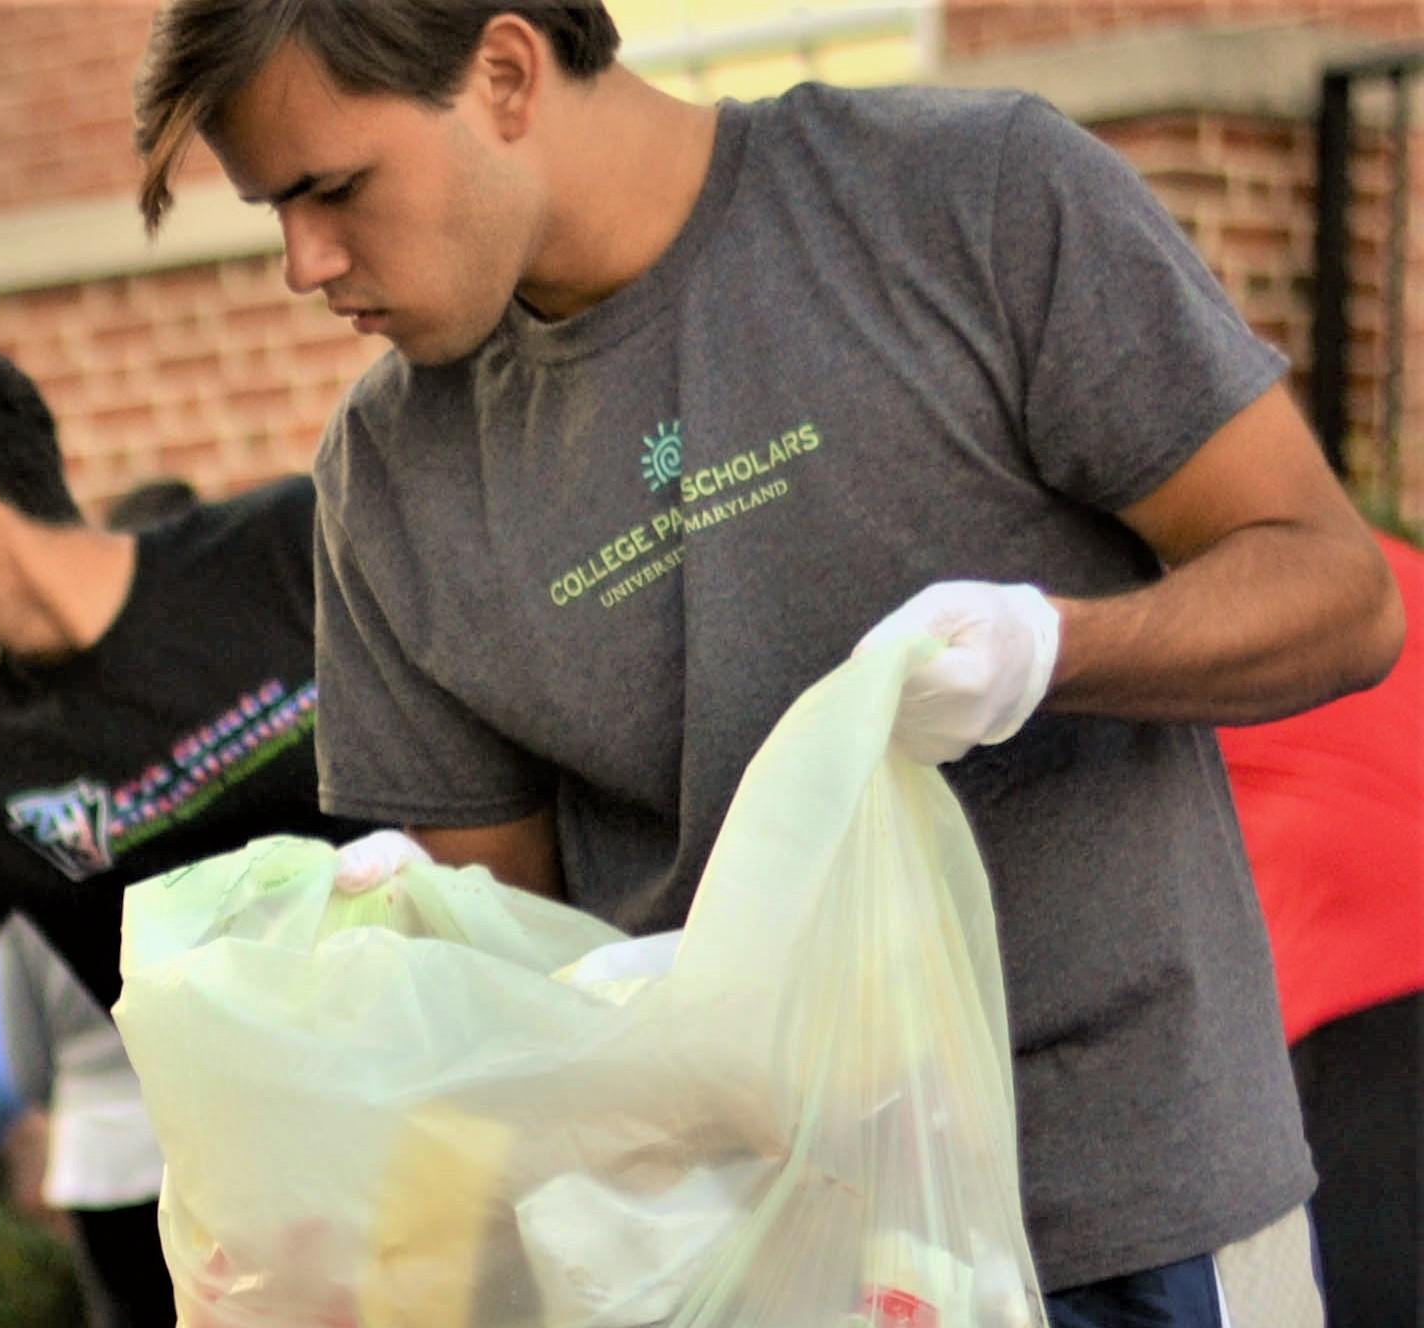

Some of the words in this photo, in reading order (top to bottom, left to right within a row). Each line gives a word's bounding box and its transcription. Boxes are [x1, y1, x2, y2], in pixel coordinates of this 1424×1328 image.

[551, 525, 654, 606] COLLEGE
[680, 422, 821, 503] SCHOLARS
[682, 478, 789, 535] MARYLAND
